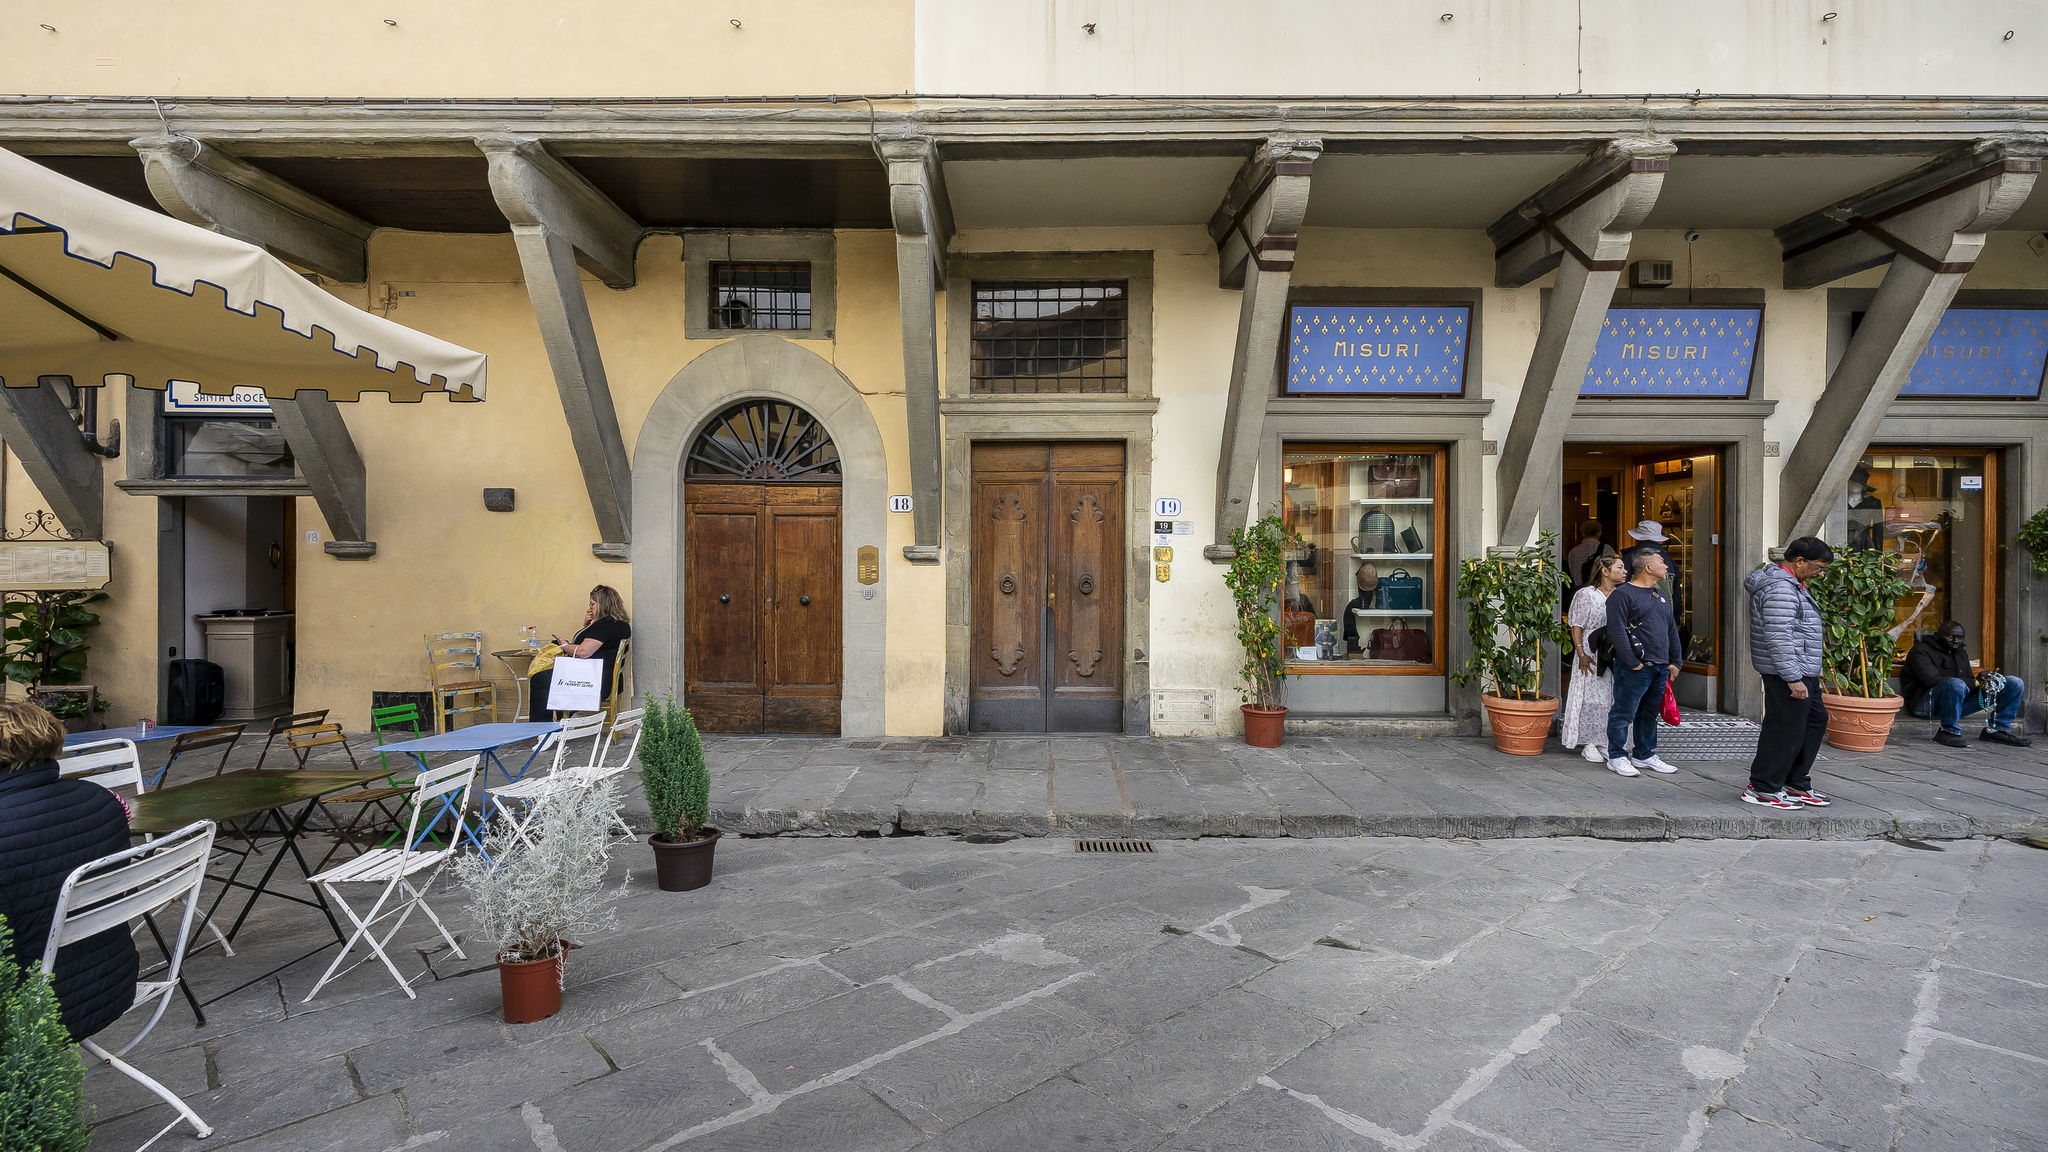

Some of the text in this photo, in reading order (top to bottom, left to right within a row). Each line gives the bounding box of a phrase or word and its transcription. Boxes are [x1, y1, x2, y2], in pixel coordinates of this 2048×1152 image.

[1333, 340, 1420, 358] MISURI
[1621, 343, 1708, 360] MISURI
[229, 393, 264, 403] CROCE
[1765, 444, 1779, 454] 20
[894, 497, 909, 510] 18
[1160, 500, 1177, 514] 19
[1159, 522, 1169, 530] 19
[307, 532, 319, 542] 18
